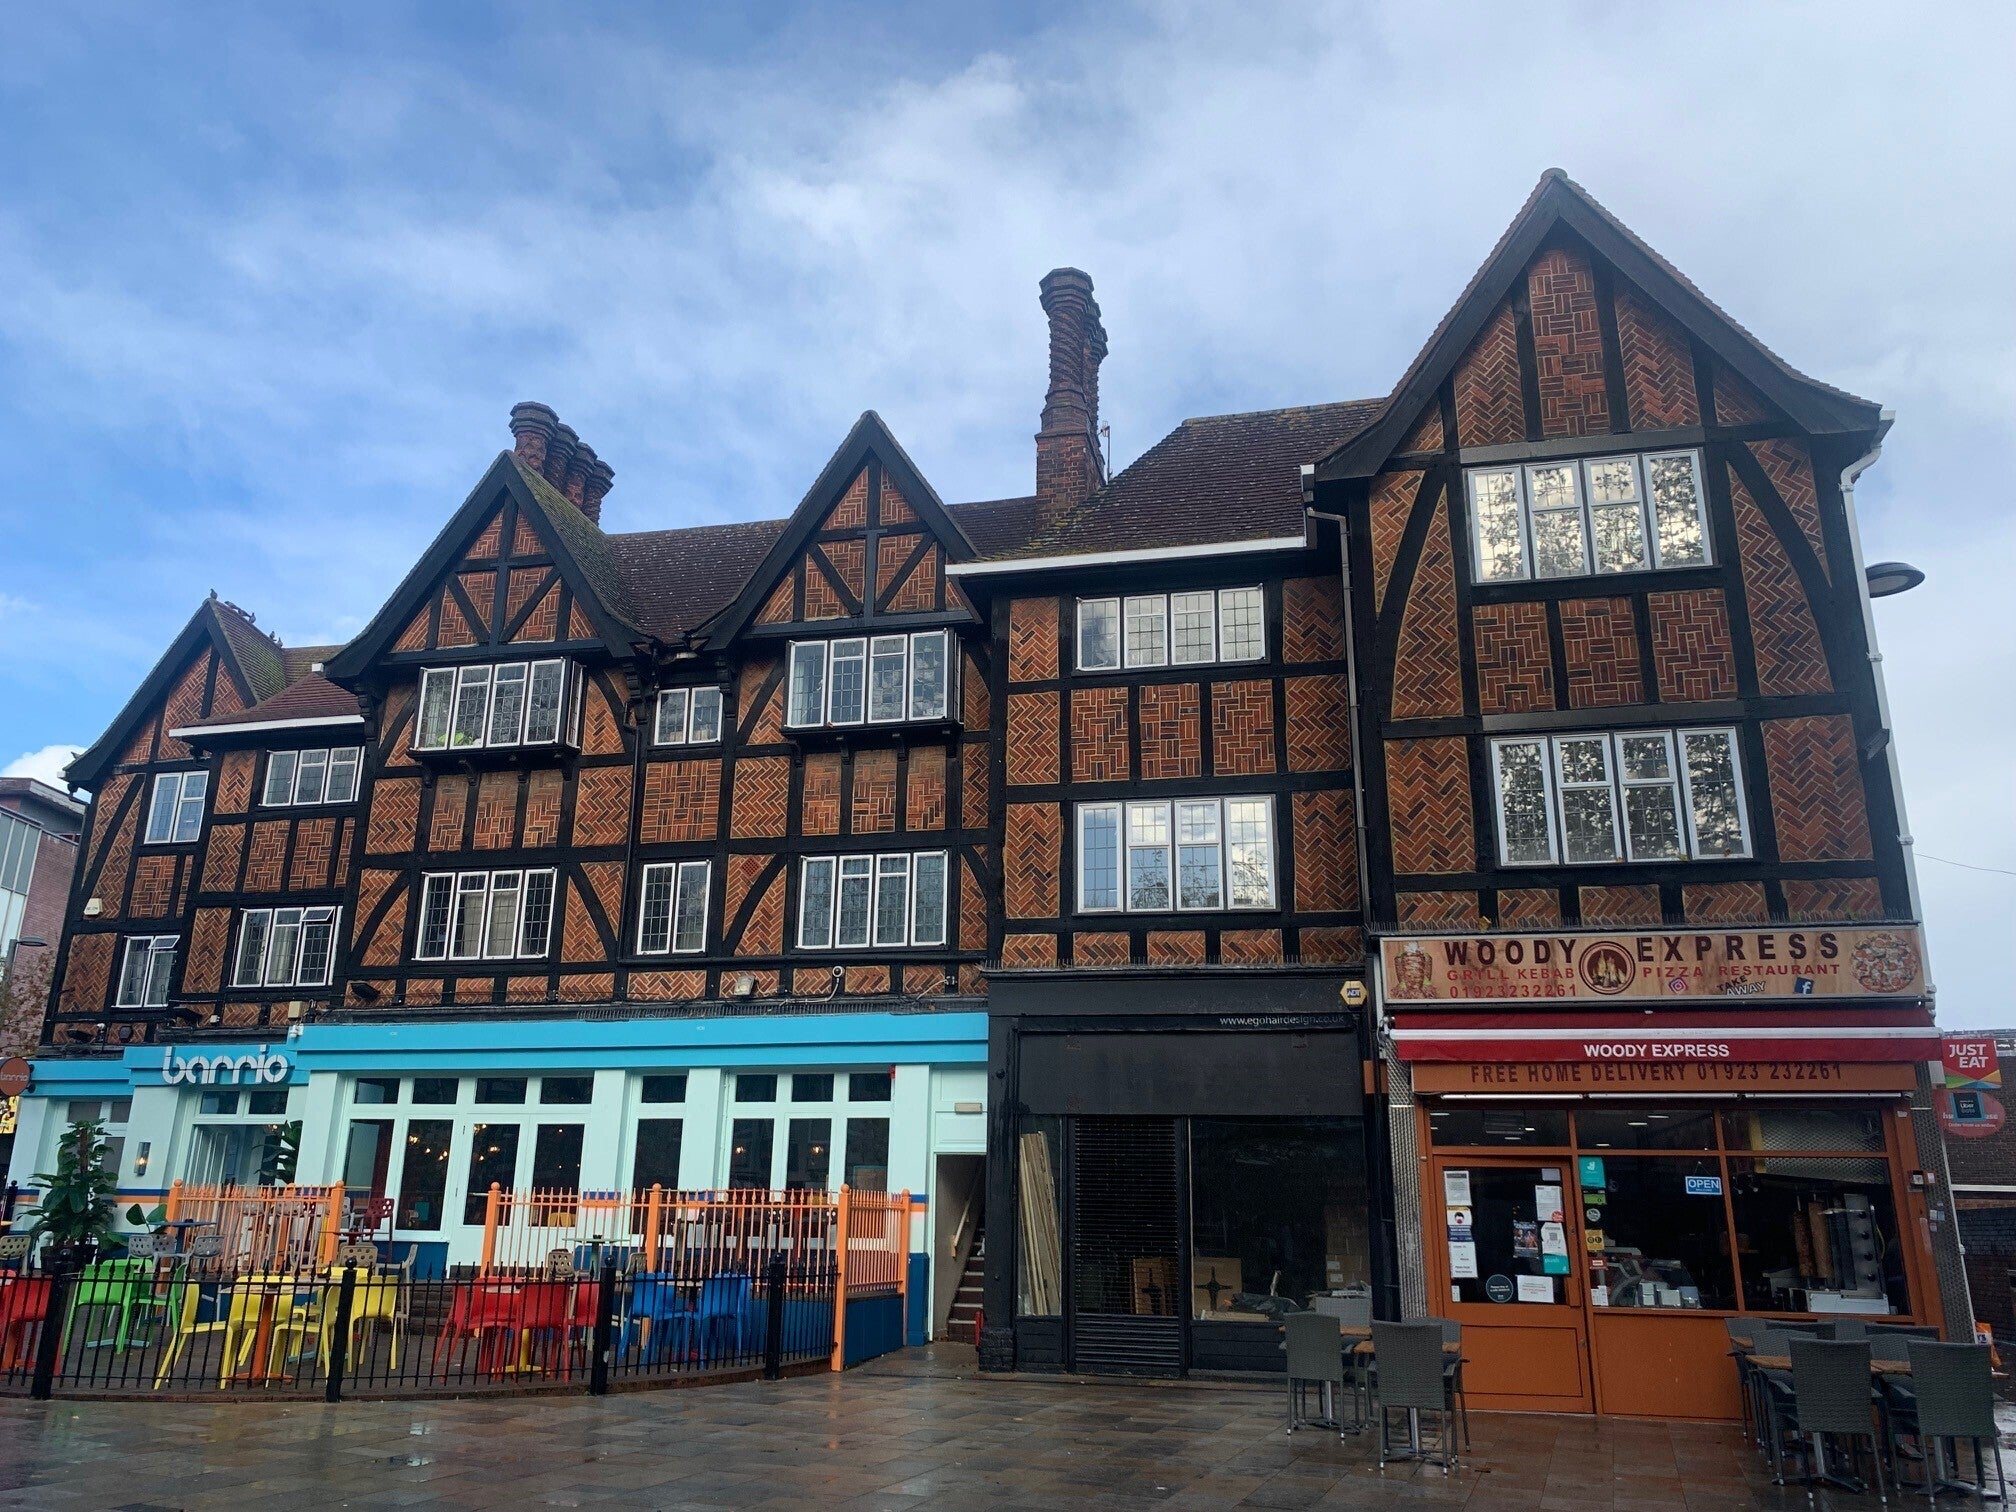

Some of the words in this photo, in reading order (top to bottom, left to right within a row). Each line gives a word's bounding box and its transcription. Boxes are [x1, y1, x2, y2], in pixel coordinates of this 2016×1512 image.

[1444, 939, 1577, 966] WOODY
[1636, 933, 1839, 962] EXPRESS
[1446, 969, 1509, 981] GRILL
[1518, 968, 1575, 979] KEBAB
[1643, 965, 1703, 978] PIZZA
[1719, 964, 1840, 976] RESTAURANT
[1450, 983, 1577, 999] 01923232261
[1716, 975, 1747, 991] TAKE
[1727, 980, 1766, 996] AWAY
[1219, 1014, 1344, 1027] www.egohairdesign.co.uk
[1583, 1044, 1647, 1058] WOODY
[1652, 1044, 1730, 1058] EXPRESS
[1949, 1044, 1986, 1057] JUST
[162, 1044, 288, 1085] barrio
[1959, 1056, 1989, 1068] EAT
[1471, 1065, 1518, 1083] FREE
[1528, 1064, 1582, 1083] HOME
[1592, 1063, 1686, 1082] DELIVERY
[1697, 1063, 1759, 1081] 01923
[1770, 1063, 1842, 1080] 232261
[1688, 1179, 1719, 1189] OPEN
